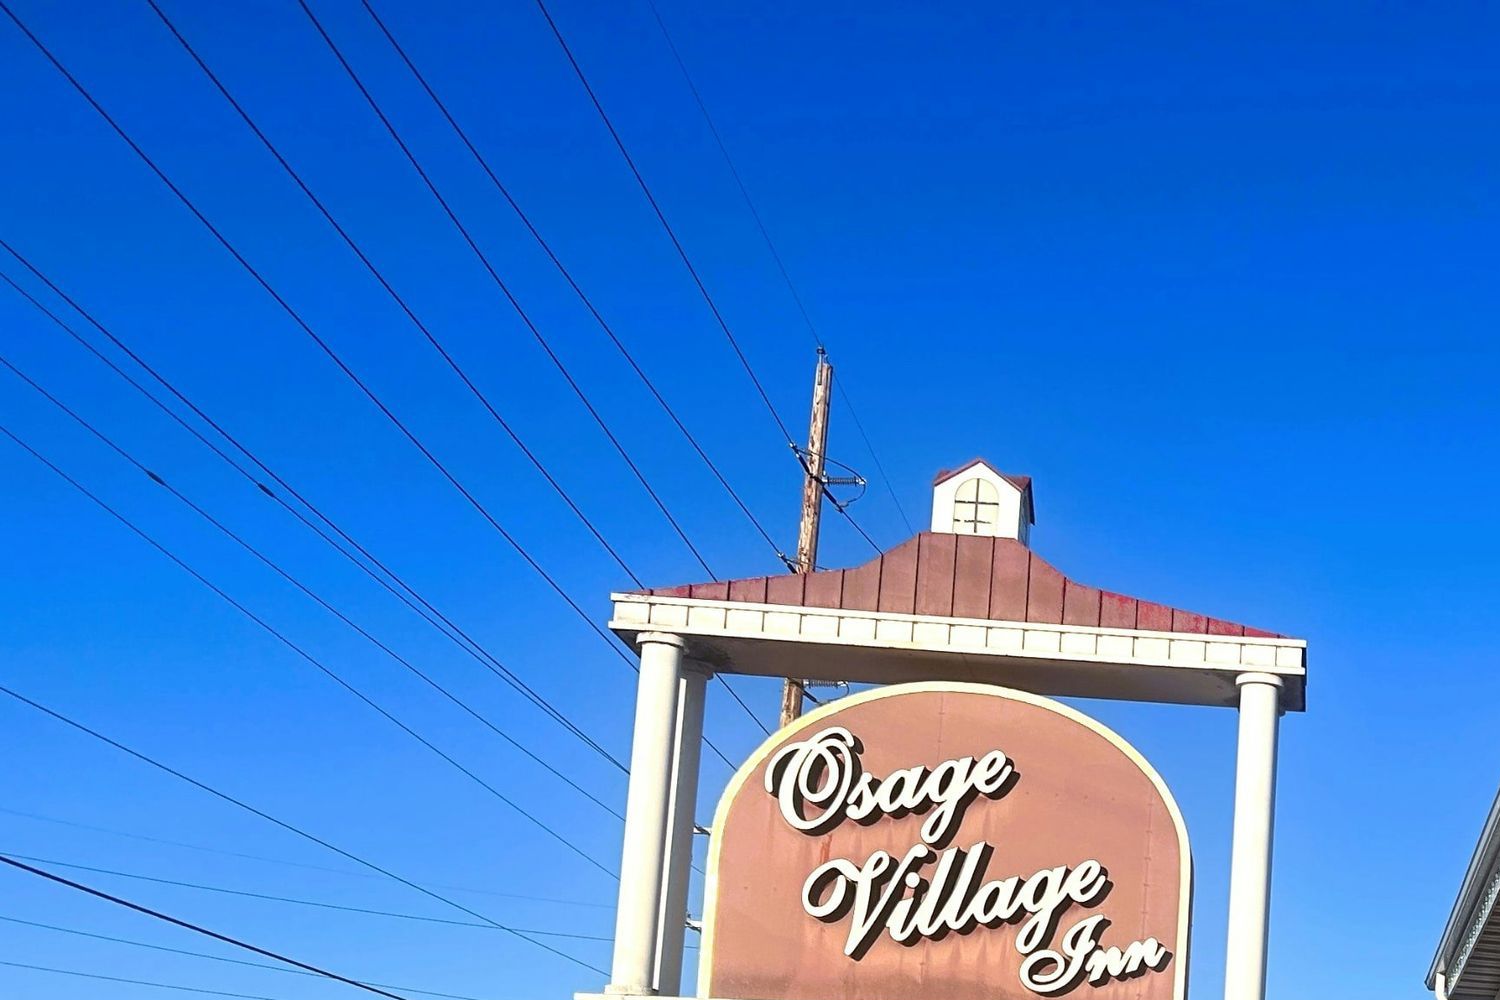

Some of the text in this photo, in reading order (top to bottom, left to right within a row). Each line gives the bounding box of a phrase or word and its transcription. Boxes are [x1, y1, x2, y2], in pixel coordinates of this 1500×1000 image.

[764, 725, 1015, 846] Osage
[801, 840, 1108, 959] Village
[1018, 913, 1168, 996] Inn
